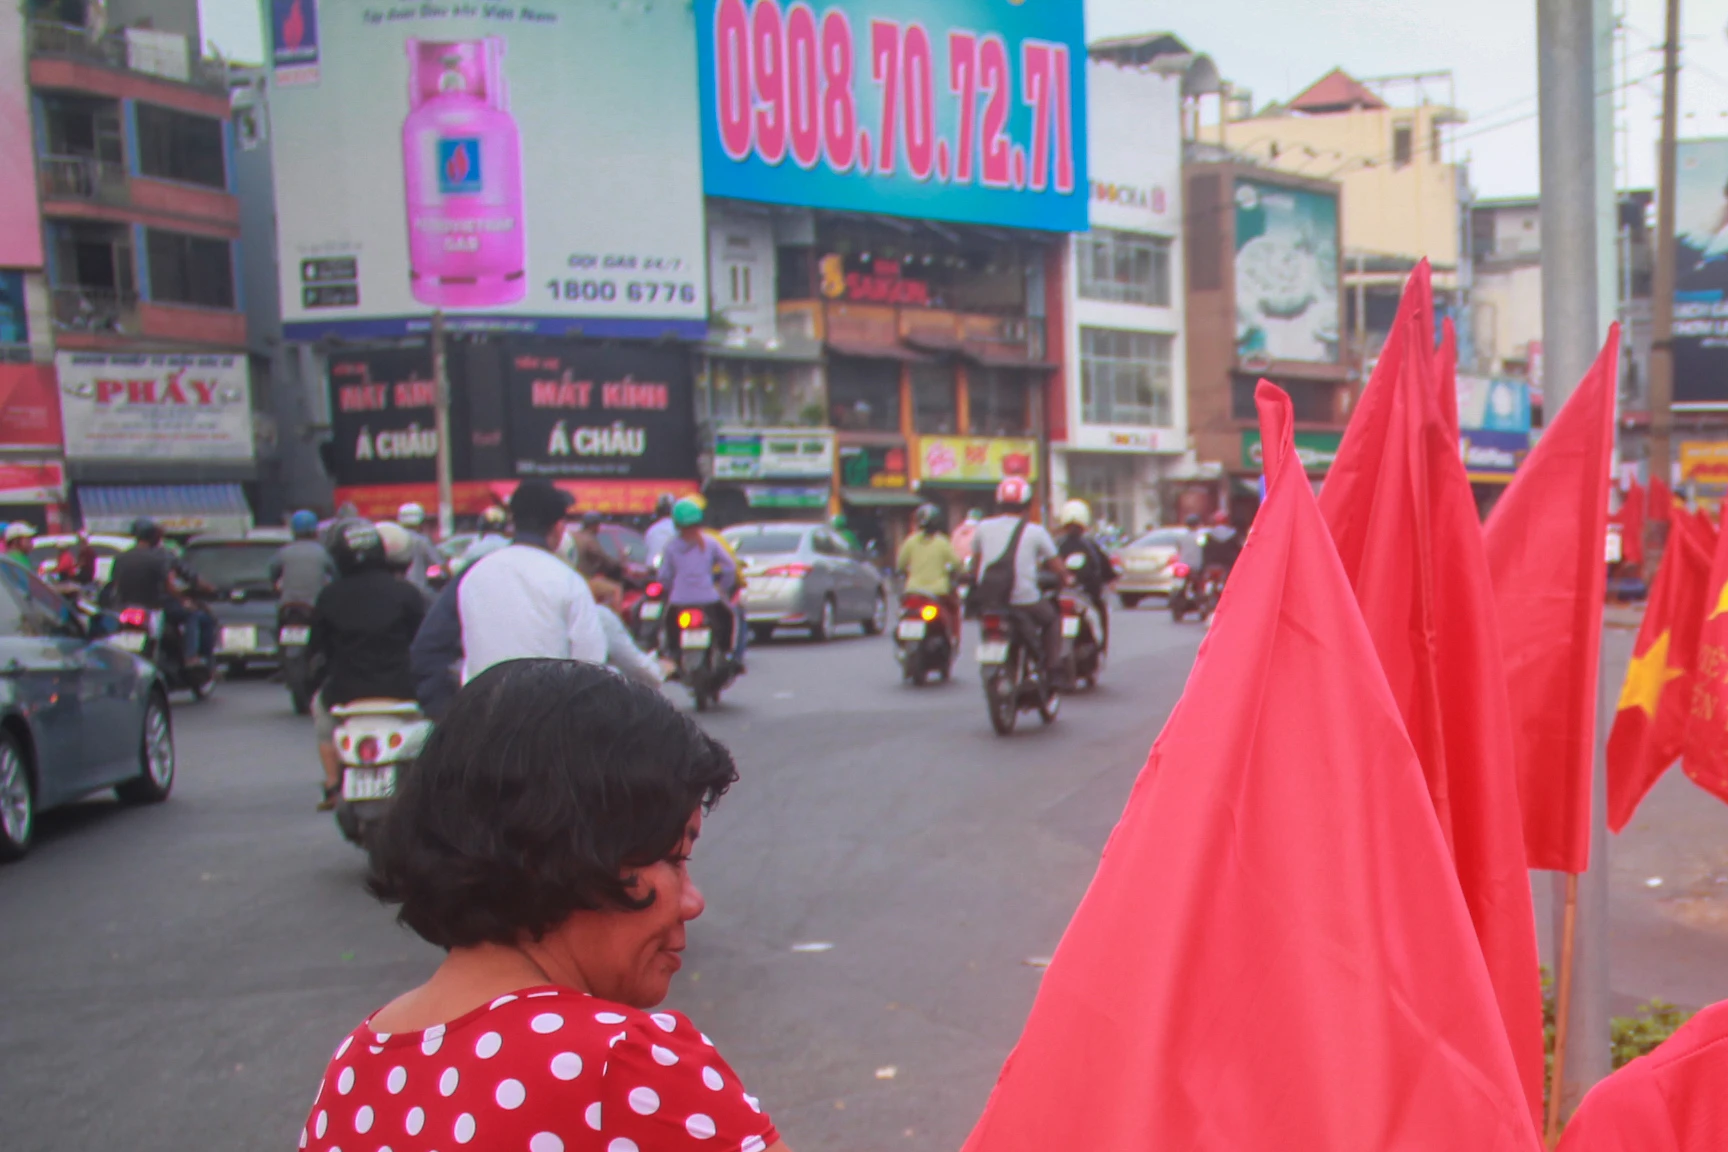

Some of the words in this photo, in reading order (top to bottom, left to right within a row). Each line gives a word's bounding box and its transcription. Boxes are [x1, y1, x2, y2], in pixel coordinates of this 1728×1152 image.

[715, 0, 1073, 193] 0908.70.72.71
[547, 278, 617, 301] 1800
[627, 280, 696, 303] 6776
[95, 366, 218, 405] PHẤY
[549, 420, 571, 455] Á
[573, 420, 647, 455] CHÂU
